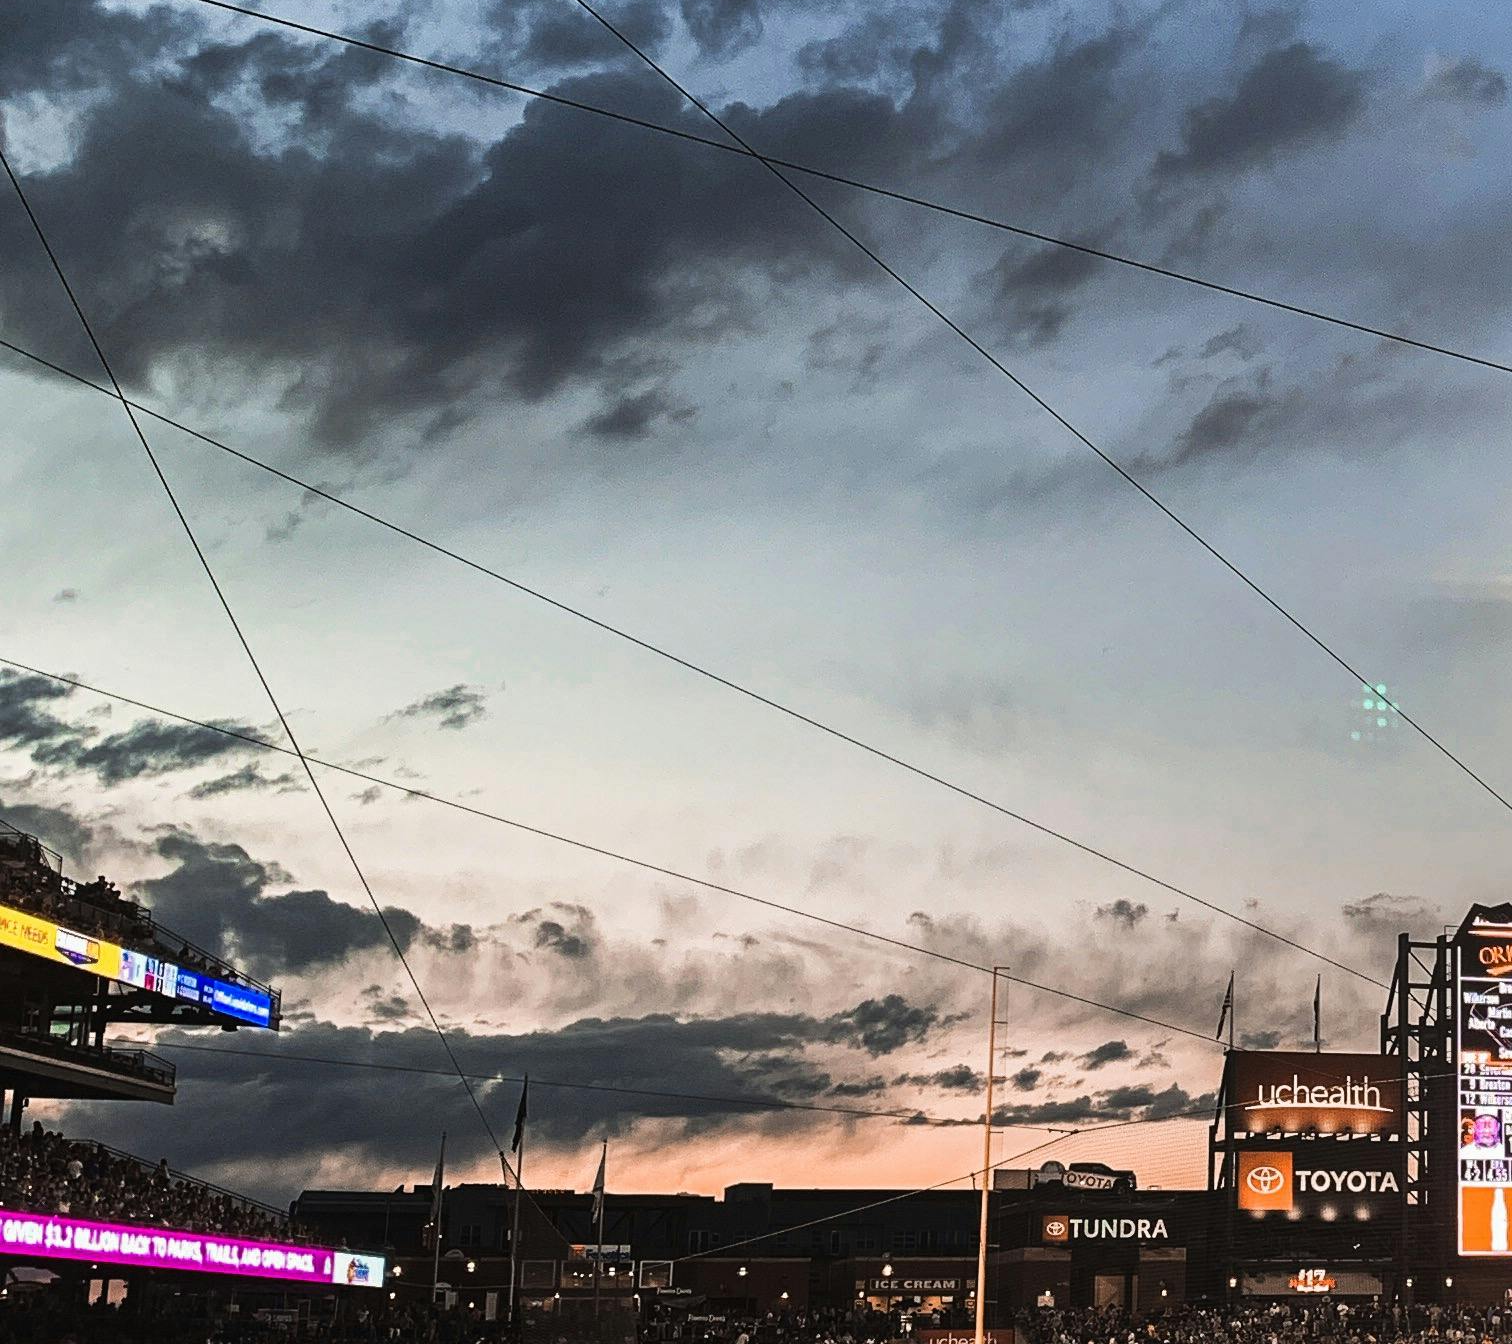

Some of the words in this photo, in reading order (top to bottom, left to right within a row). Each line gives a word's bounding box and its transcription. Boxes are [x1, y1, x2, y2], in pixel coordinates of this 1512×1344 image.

[1258, 1074, 1381, 1109] uchealth
[1061, 1171, 1115, 1190] TOYOTA
[1296, 1170, 1399, 1193] TOYOTA
[1069, 1218, 1169, 1239] TUNDRA
[874, 1279, 898, 1290] ICE
[903, 1279, 957, 1290] CREAM
